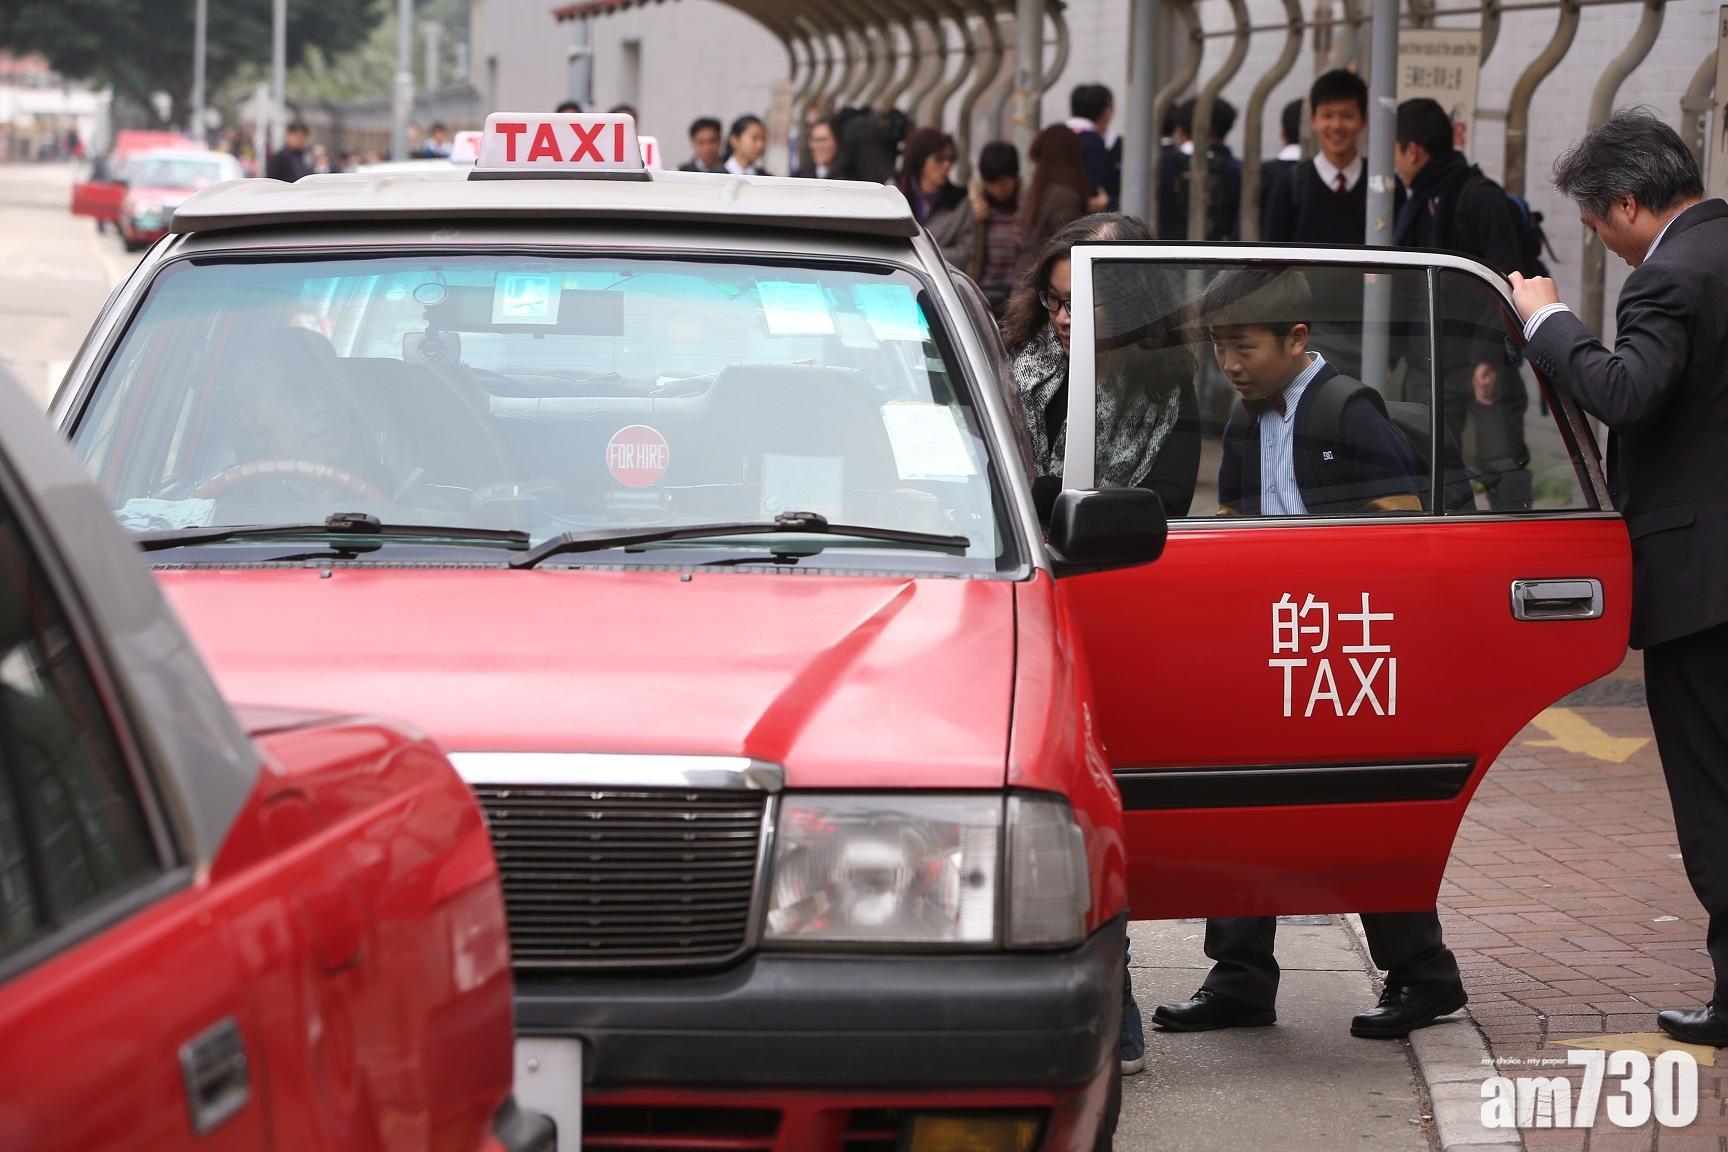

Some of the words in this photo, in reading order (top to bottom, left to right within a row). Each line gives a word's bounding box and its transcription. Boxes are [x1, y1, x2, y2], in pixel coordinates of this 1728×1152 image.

[496, 123, 624, 162] TAXI
[610, 443, 634, 469] FOR
[636, 443, 665, 469] HIRE
[1272, 592, 1394, 653] 的士
[1268, 658, 1397, 717] TAXI
